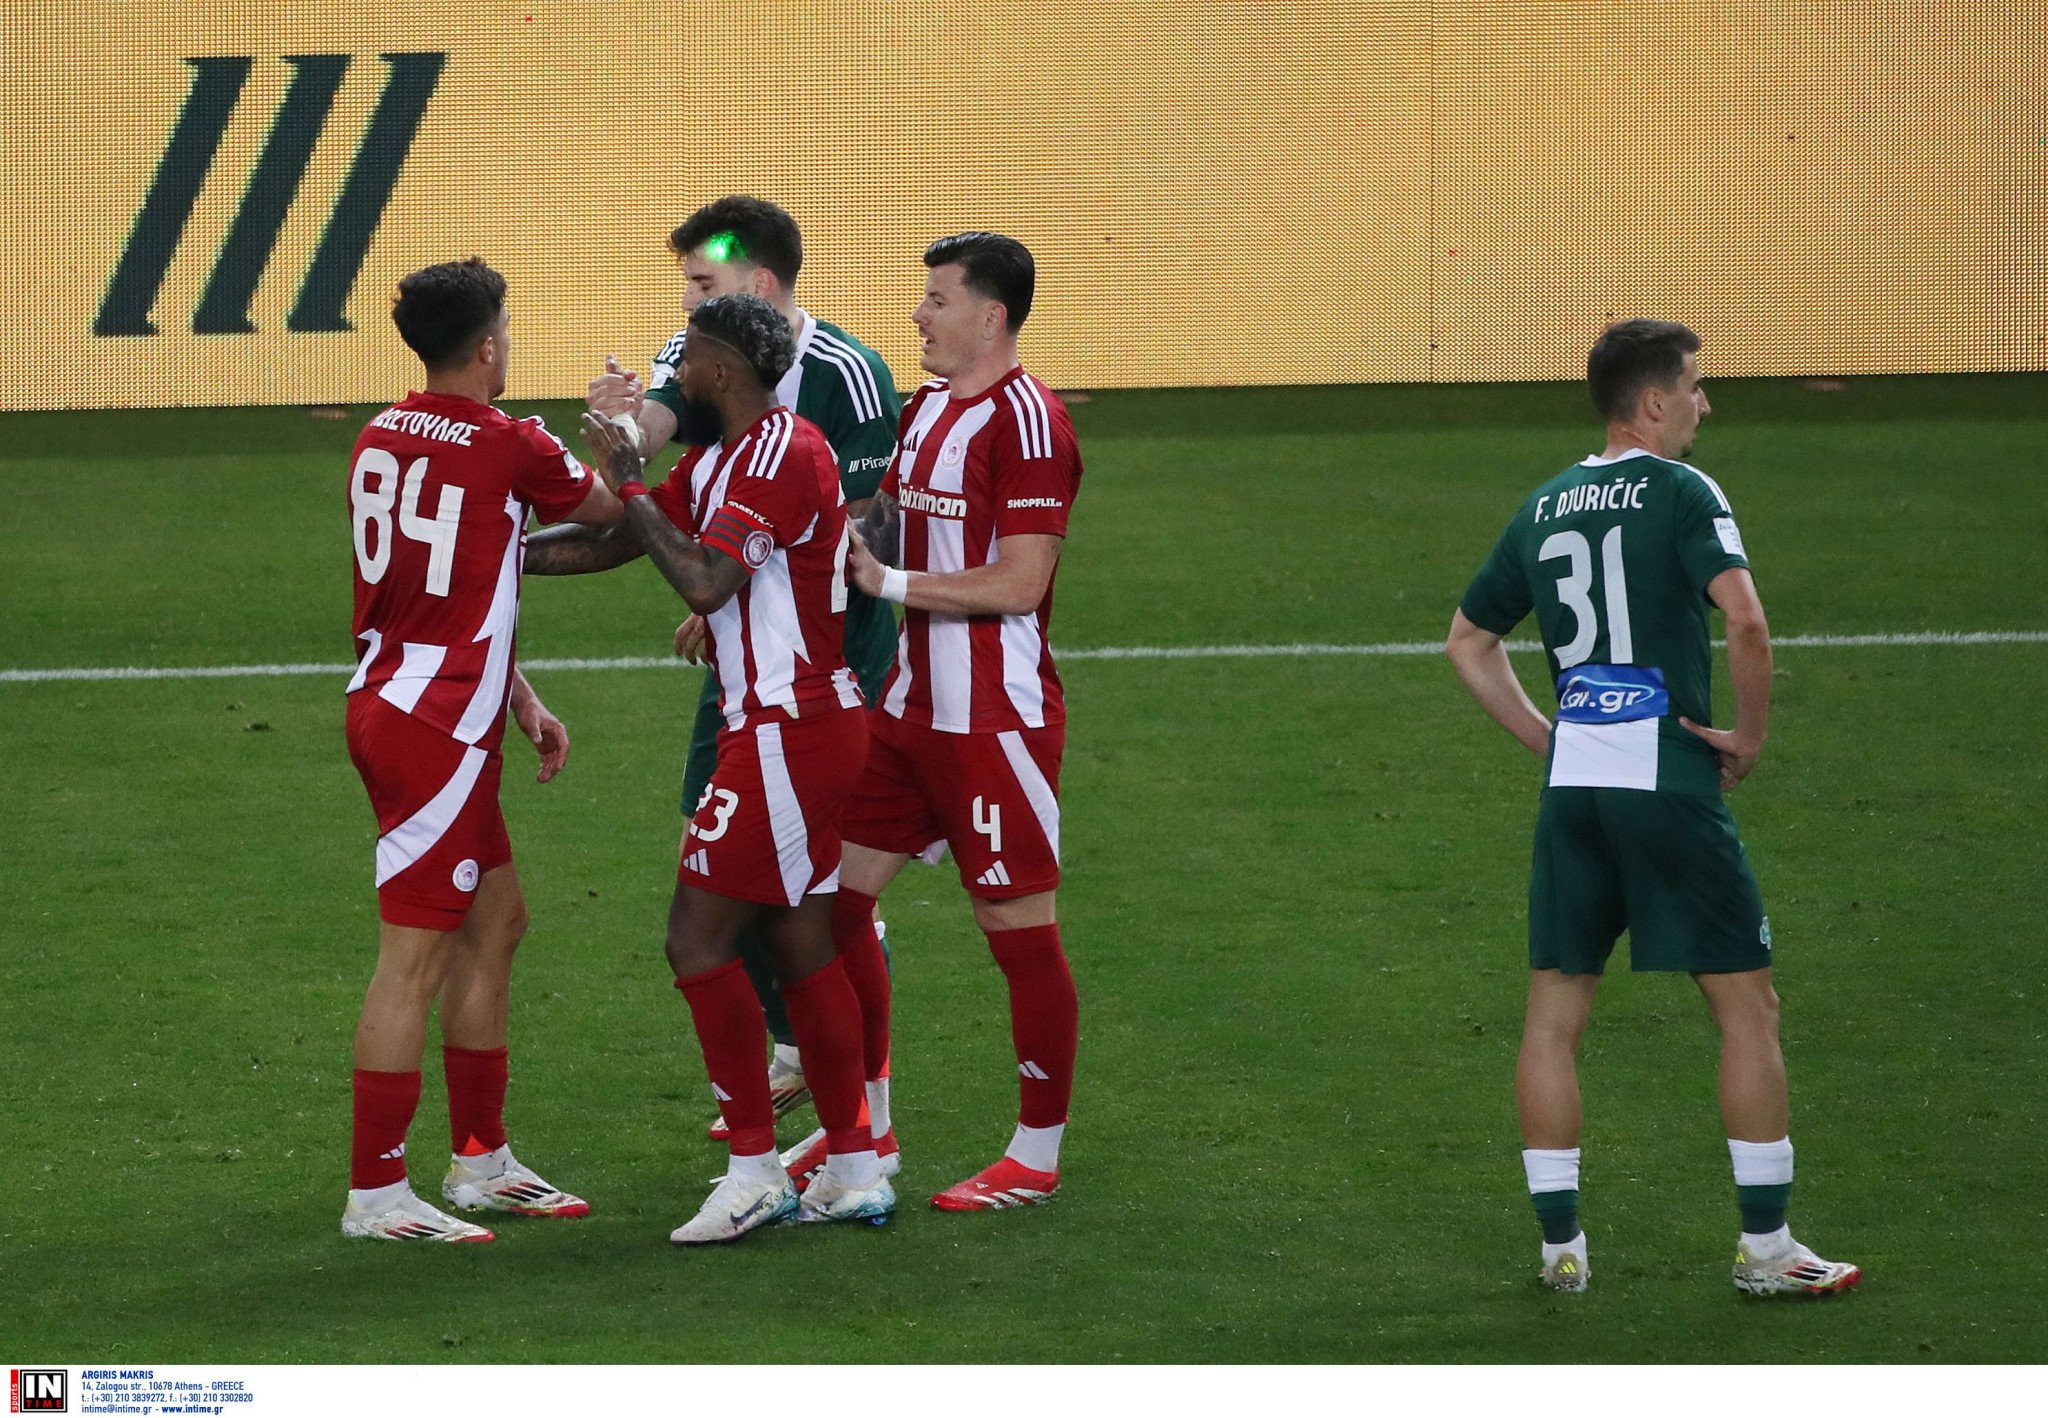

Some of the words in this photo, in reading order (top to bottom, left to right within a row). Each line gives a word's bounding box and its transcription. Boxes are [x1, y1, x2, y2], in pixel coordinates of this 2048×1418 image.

[351, 447, 465, 597] 84
[1535, 495, 1550, 523] F.
[1555, 476, 1649, 519] DJURIČIĆ
[1538, 525, 1633, 669] 31
[972, 795, 1001, 852] 4
